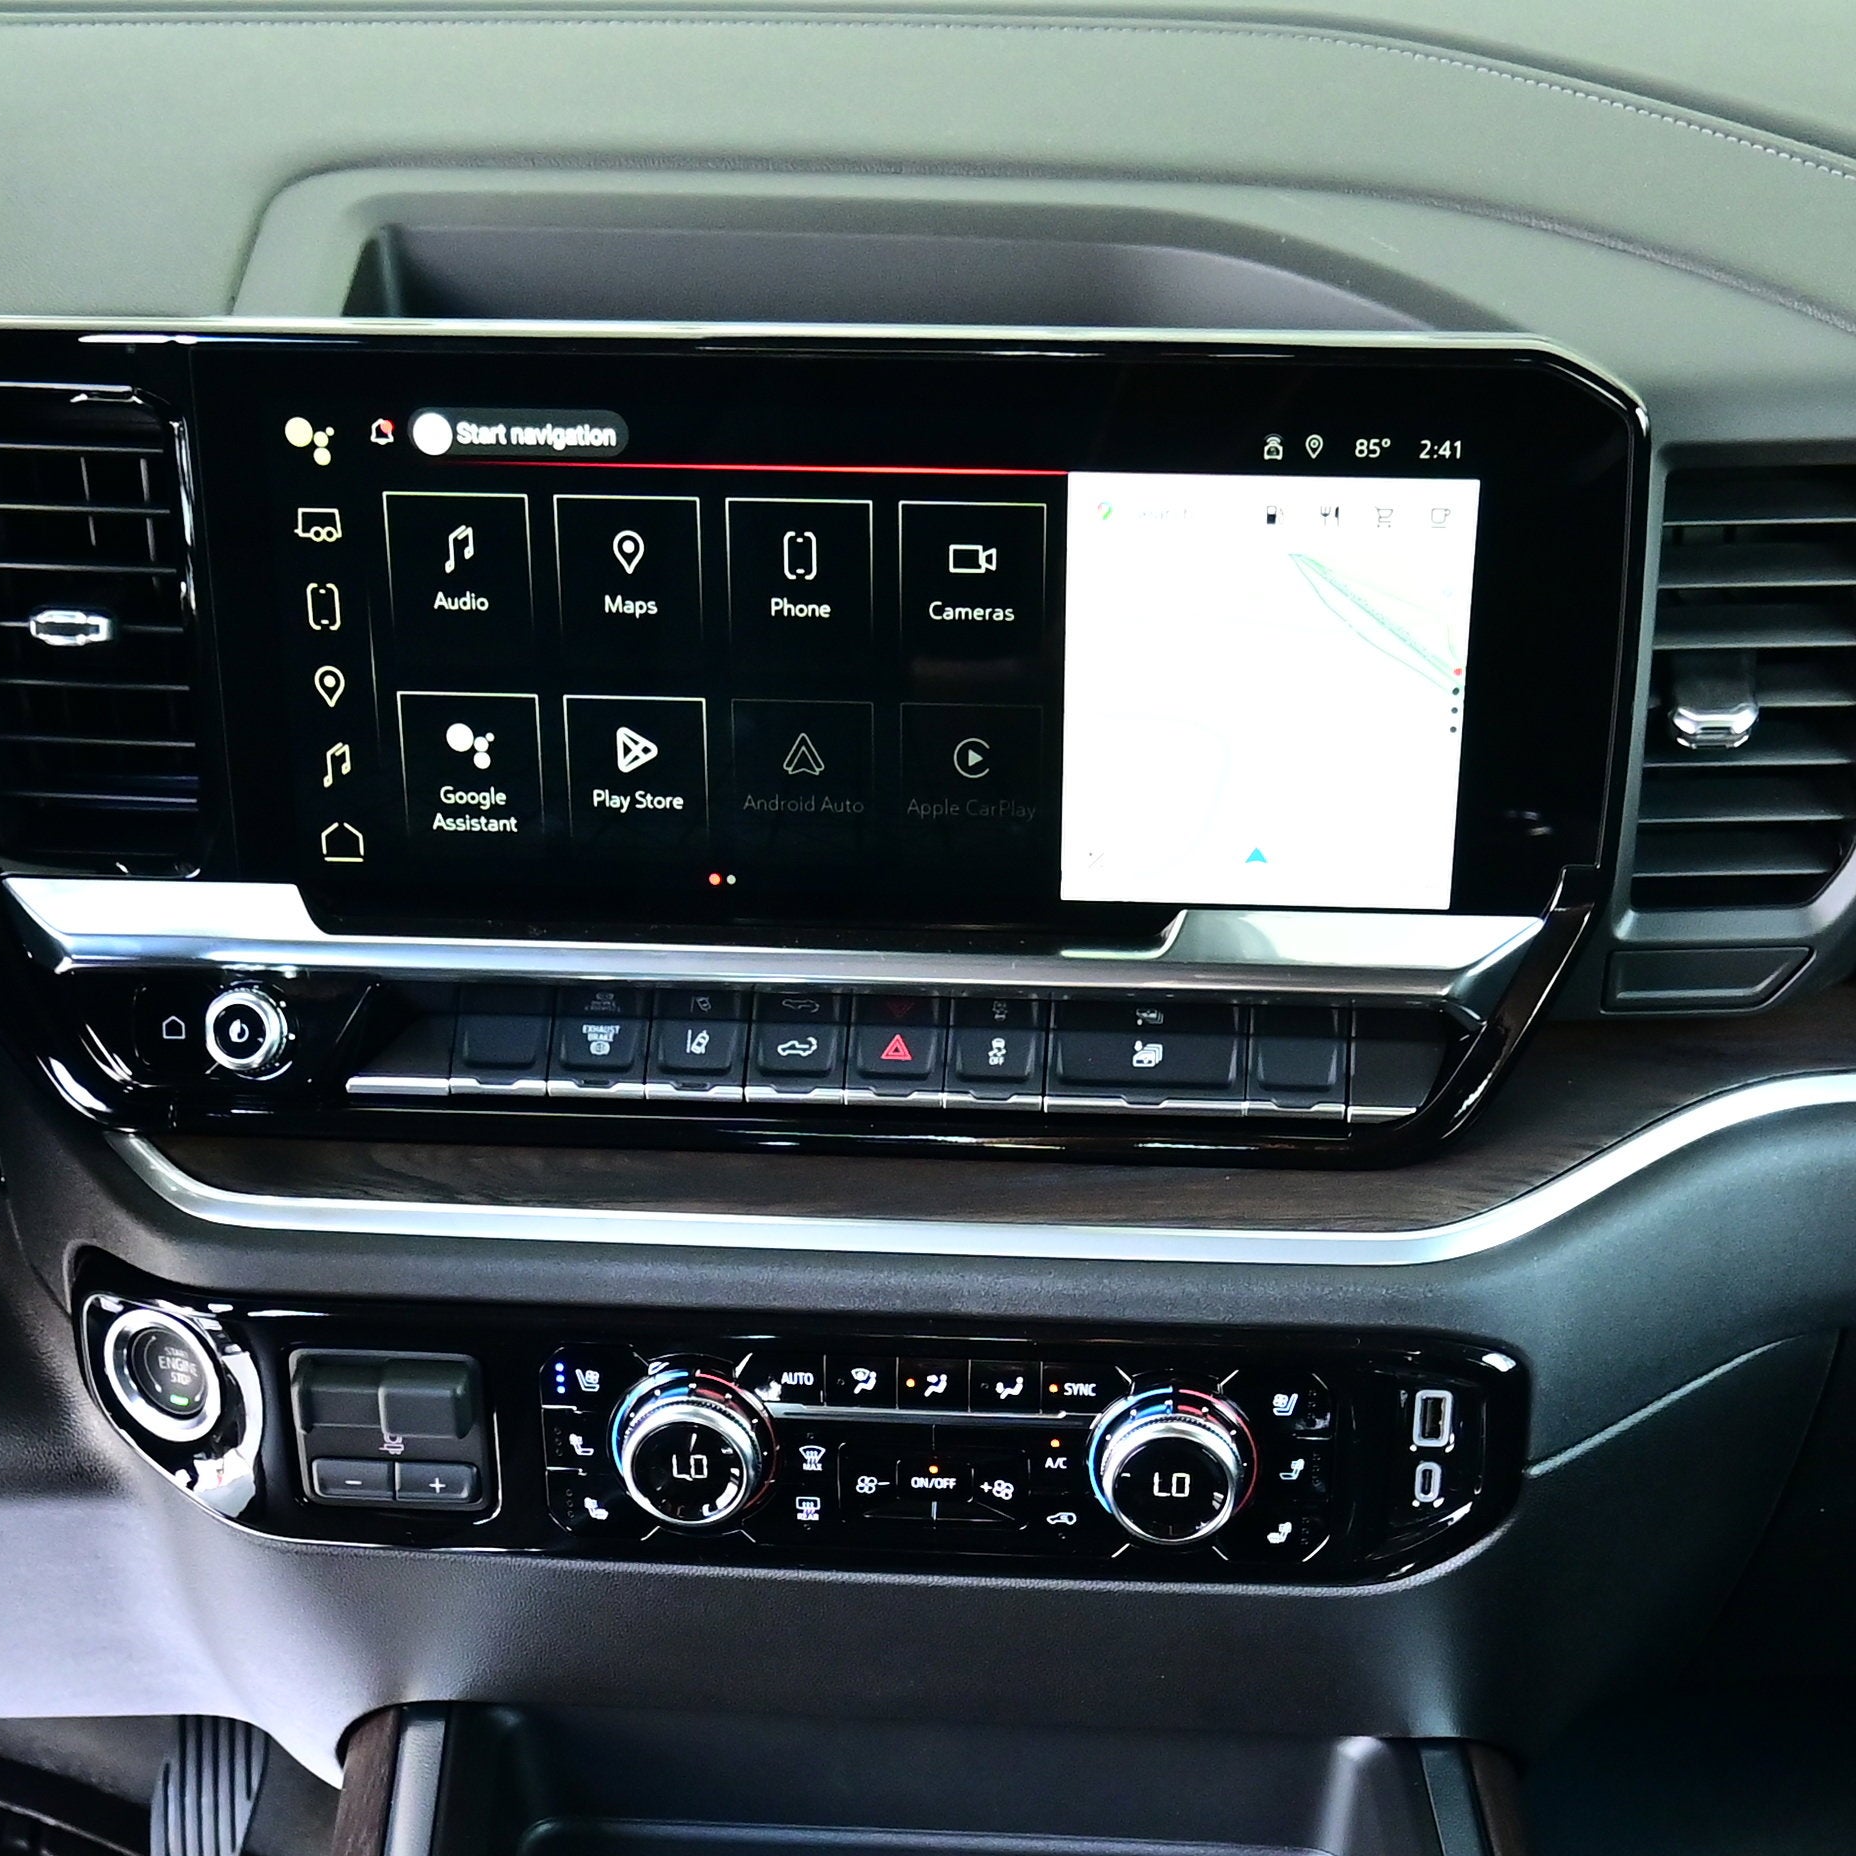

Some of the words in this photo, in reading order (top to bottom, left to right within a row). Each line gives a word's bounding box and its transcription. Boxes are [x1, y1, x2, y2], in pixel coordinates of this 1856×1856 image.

[456, 421, 507, 446] Start
[510, 423, 618, 451] navigation
[1418, 439, 1464, 460] 2:41
[433, 591, 489, 612] Audio
[603, 594, 659, 619] Maps
[770, 597, 832, 619] Phone
[928, 600, 1016, 624] Cameras
[439, 785, 507, 810] Google
[592, 789, 631, 813] Play
[634, 790, 685, 810] Store
[742, 793, 816, 813] Android
[820, 796, 866, 815] Auto
[906, 798, 961, 820] Apple
[964, 799, 1037, 823] CarPlay
[432, 812, 518, 833] Assistant
[582, 1024, 621, 1035] EXHAUST
[157, 1355, 199, 1378] ENGINE
[169, 1370, 194, 1386] STOP
[780, 1371, 815, 1386] AUTO
[1063, 1383, 1098, 1397] SYNC
[802, 1462, 823, 1472] MAX
[1044, 1456, 1068, 1470] A/C
[910, 1477, 957, 1490] ON/OFF
[1152, 1471, 1191, 1498] LO
